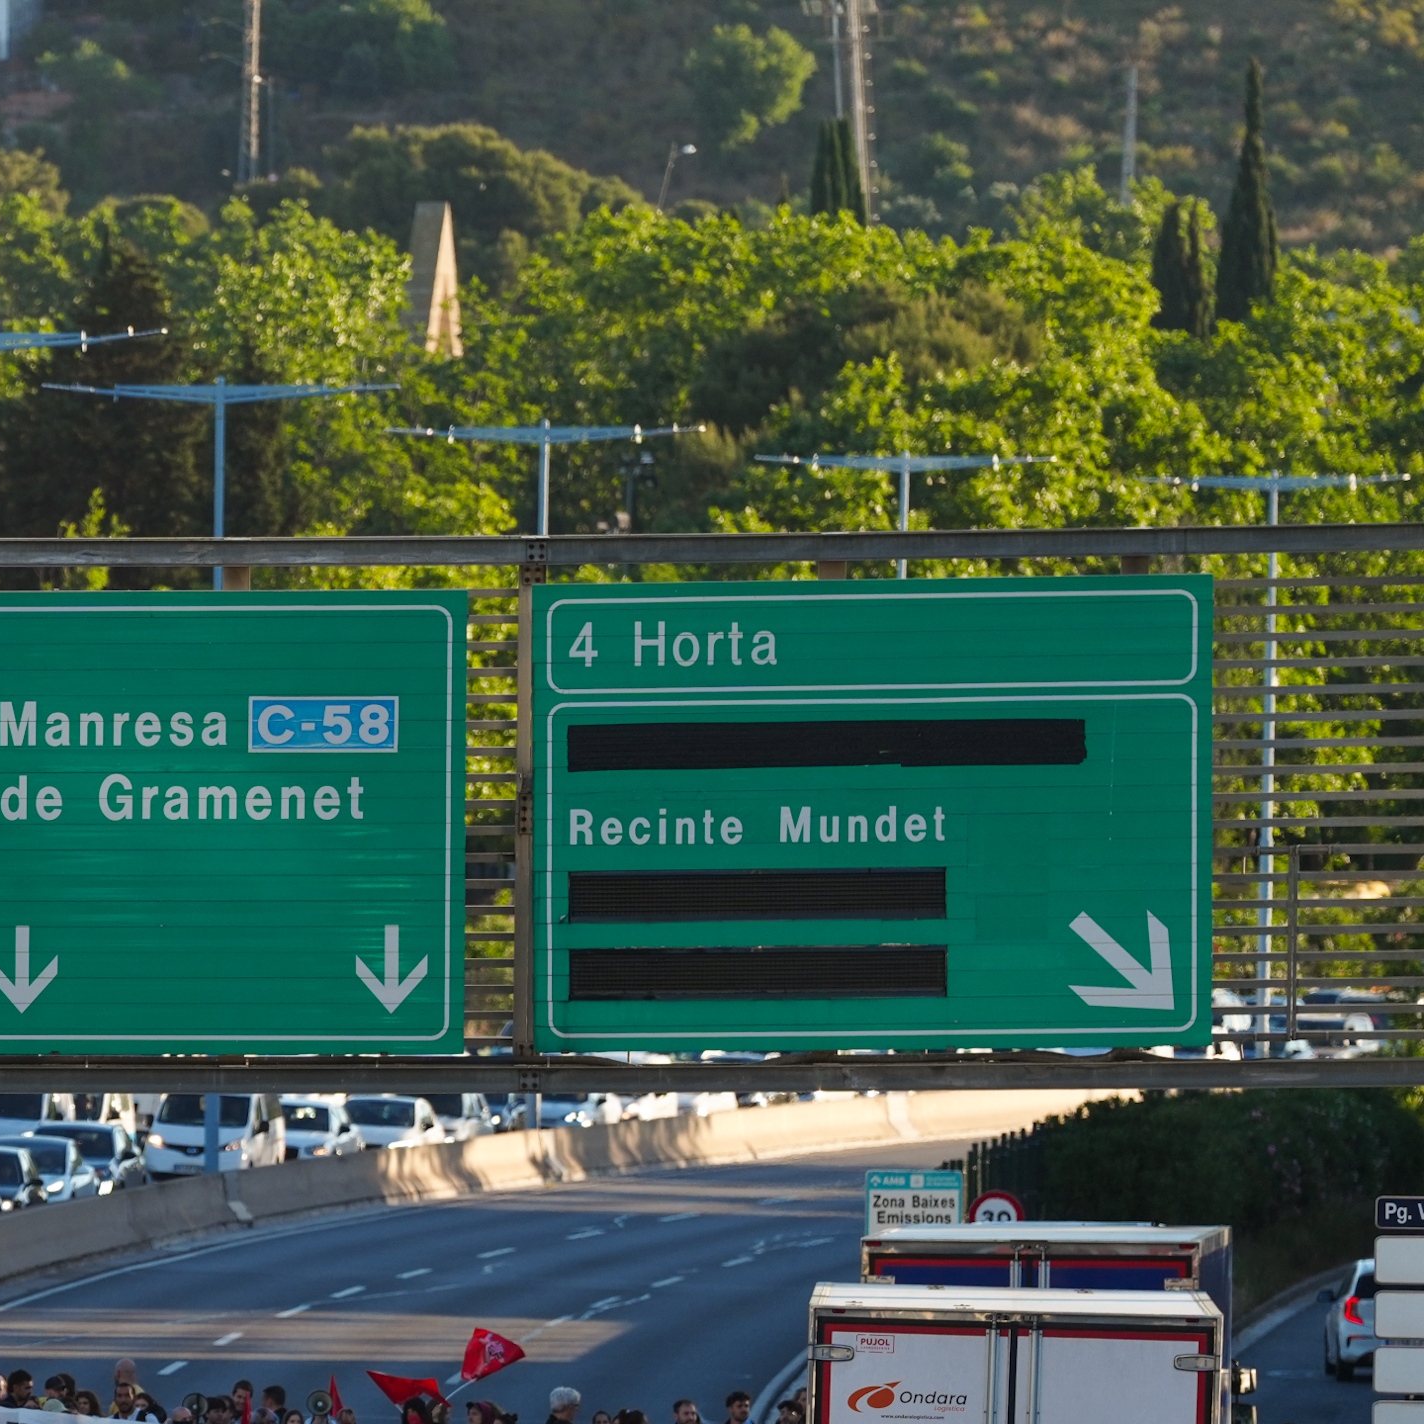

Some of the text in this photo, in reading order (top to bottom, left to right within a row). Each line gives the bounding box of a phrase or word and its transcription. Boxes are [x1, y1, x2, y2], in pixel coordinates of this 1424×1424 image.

[567, 619, 778, 668] 4 Horta
[256, 703, 392, 746] C-58
[0, 774, 64, 823] de
[97, 772, 366, 823] Gramenet
[568, 804, 948, 847] Recinte Mundet
[873, 1194, 956, 1209] Zona Baixes
[876, 1211, 952, 1225] Emissions
[1384, 1202, 1413, 1224] Pg.
[860, 1338, 891, 1347] PUJOL
[899, 1391, 968, 1405] Ondara
